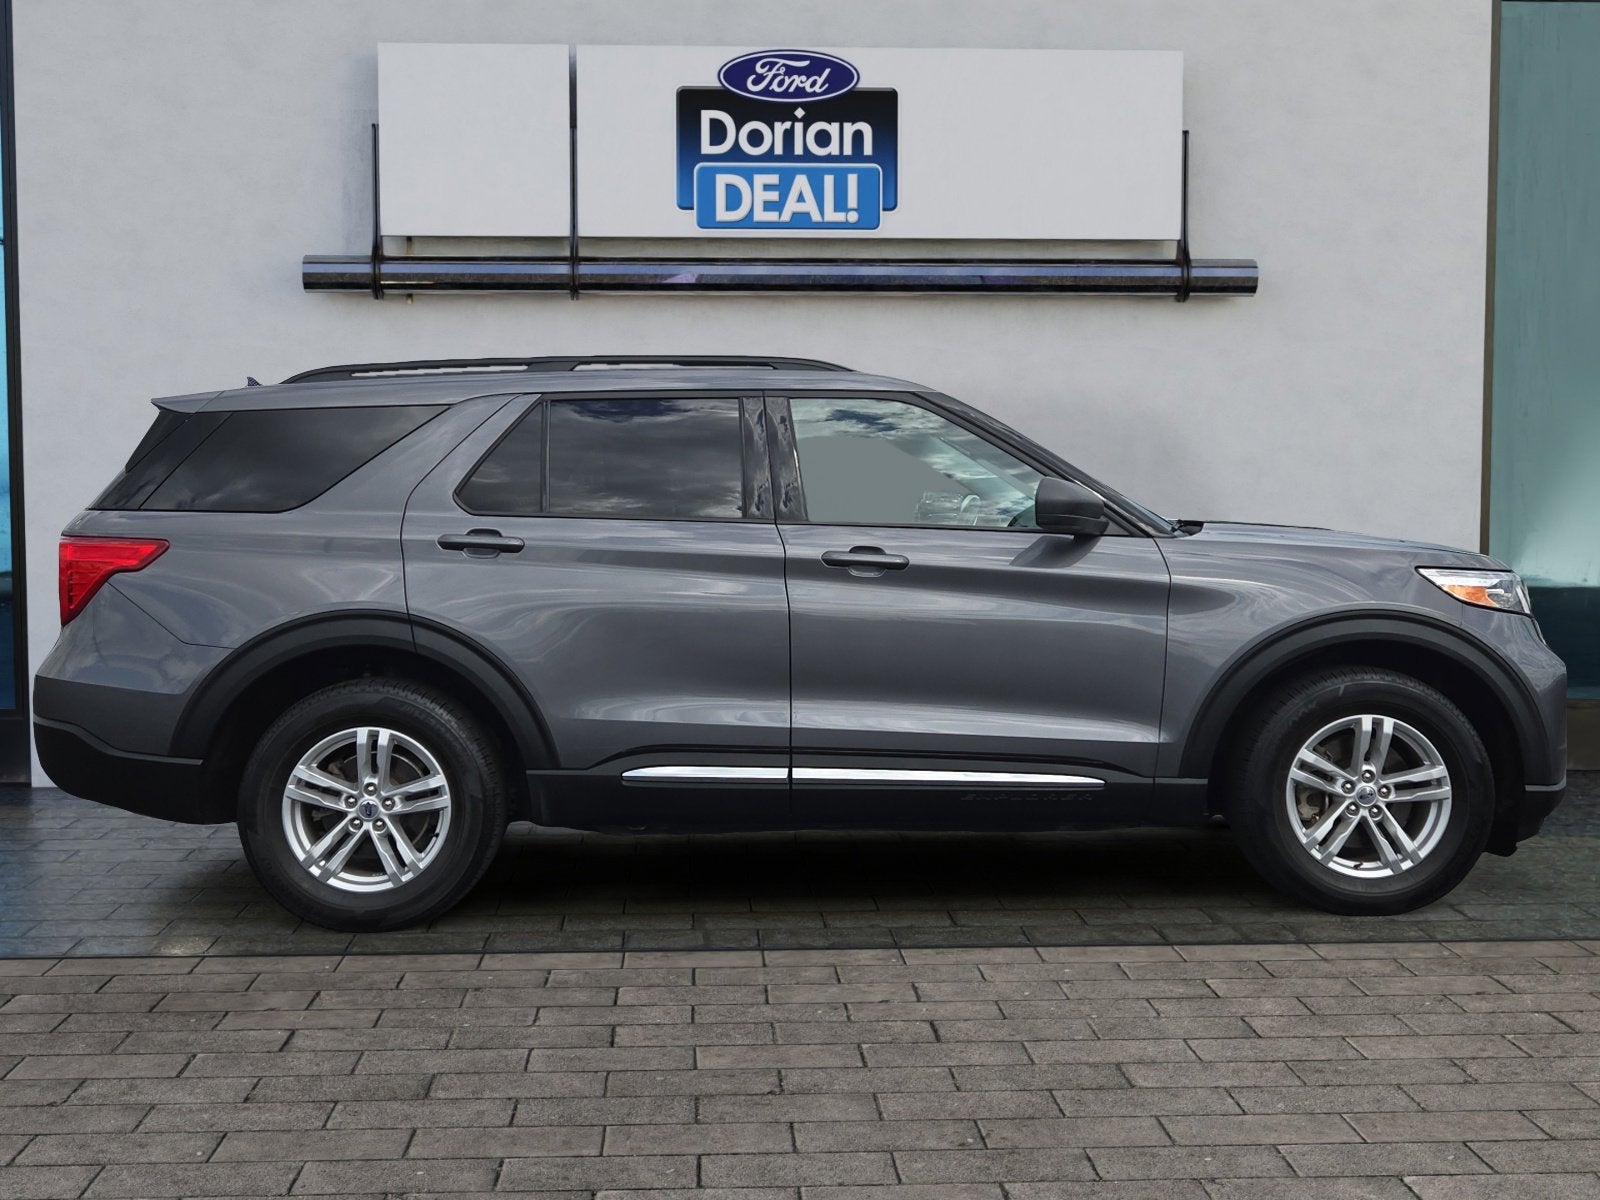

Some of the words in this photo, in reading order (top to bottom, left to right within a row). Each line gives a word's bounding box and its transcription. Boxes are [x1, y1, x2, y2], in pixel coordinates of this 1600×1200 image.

[746, 57, 832, 93] Ford
[700, 107, 873, 156] Dorian
[715, 173, 859, 224] DEAL!
